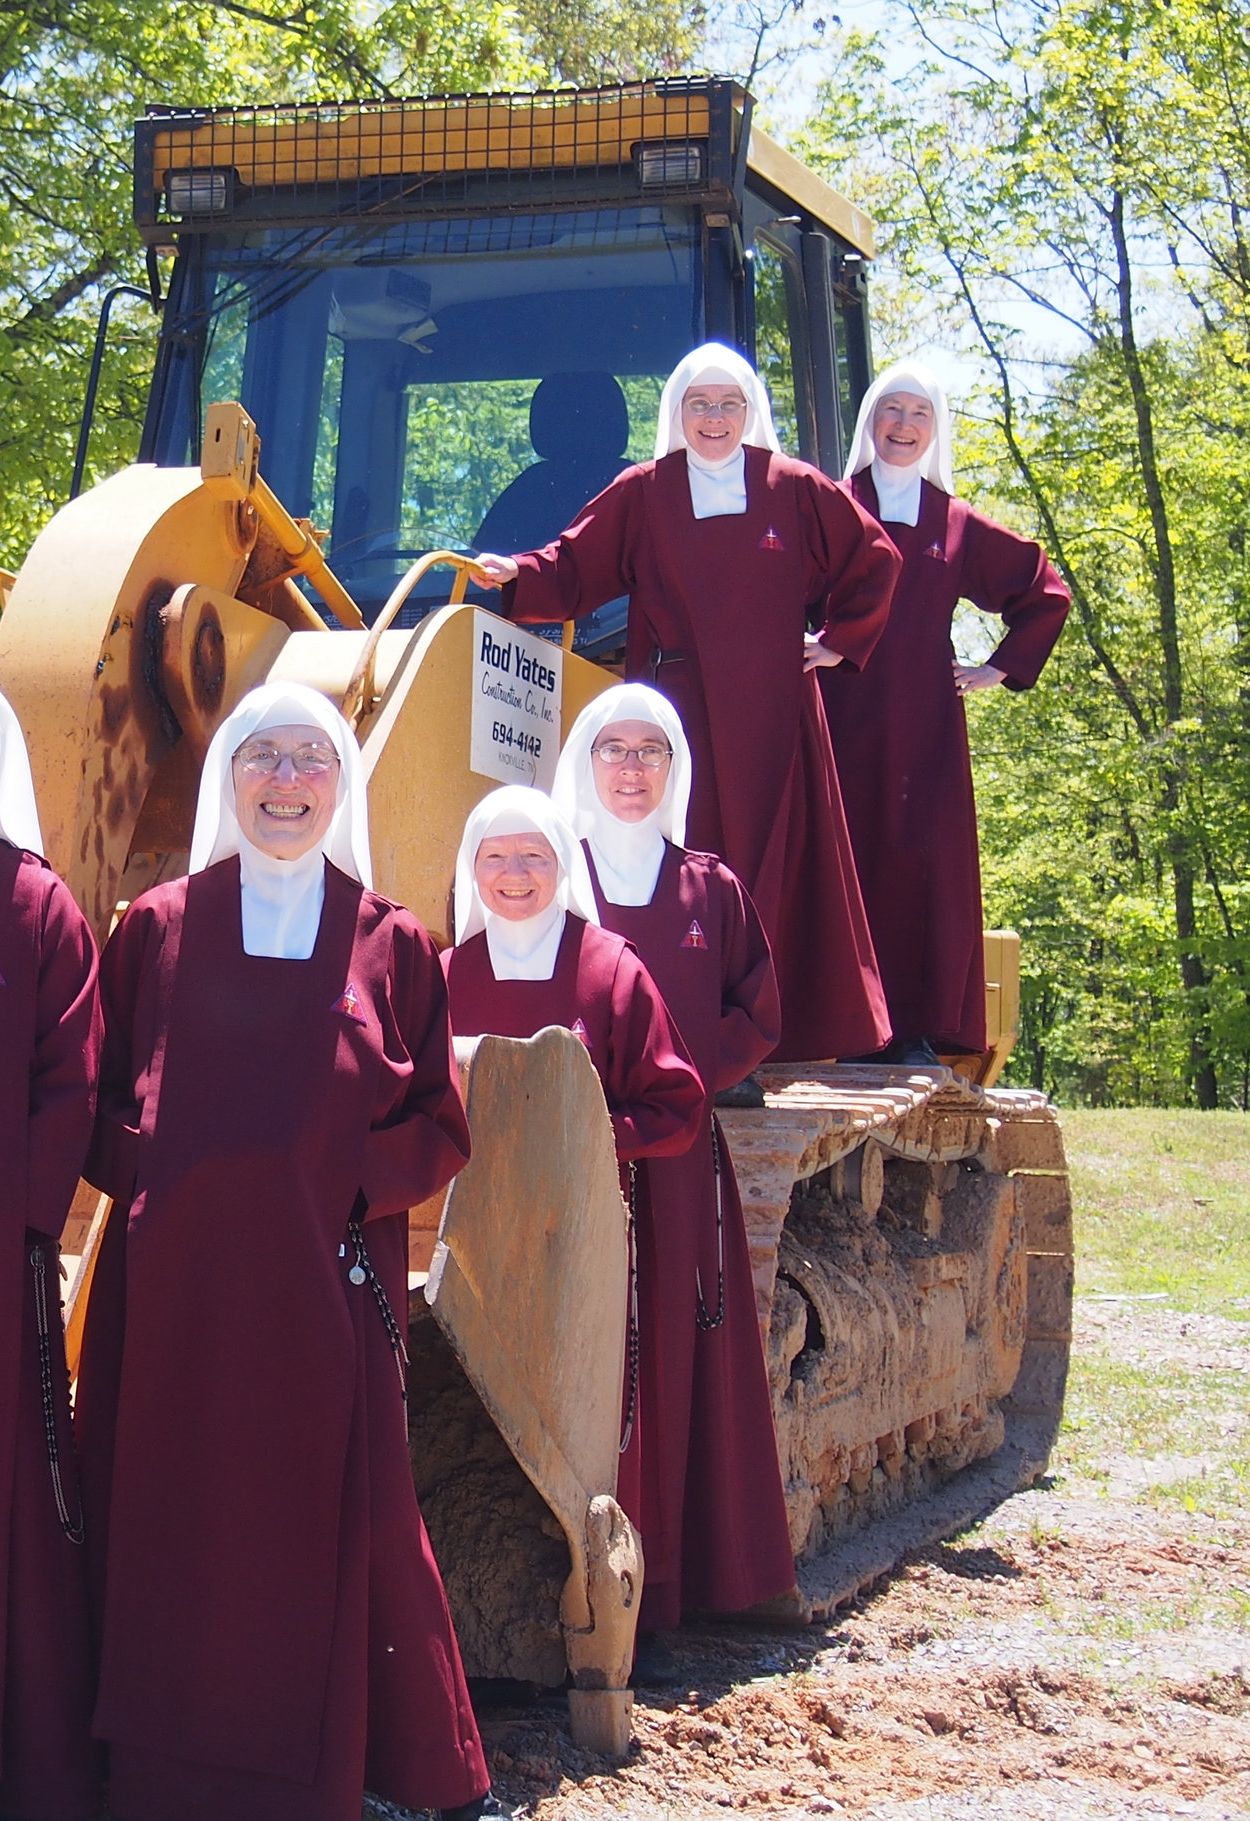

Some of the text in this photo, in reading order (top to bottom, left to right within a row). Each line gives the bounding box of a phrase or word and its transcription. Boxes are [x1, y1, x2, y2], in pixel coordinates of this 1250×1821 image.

[480, 631, 556, 693] Rod Yates
[481, 671, 523, 709] Construction
[541, 697, 554, 723] Inc.
[492, 721, 542, 758] 694-4142
